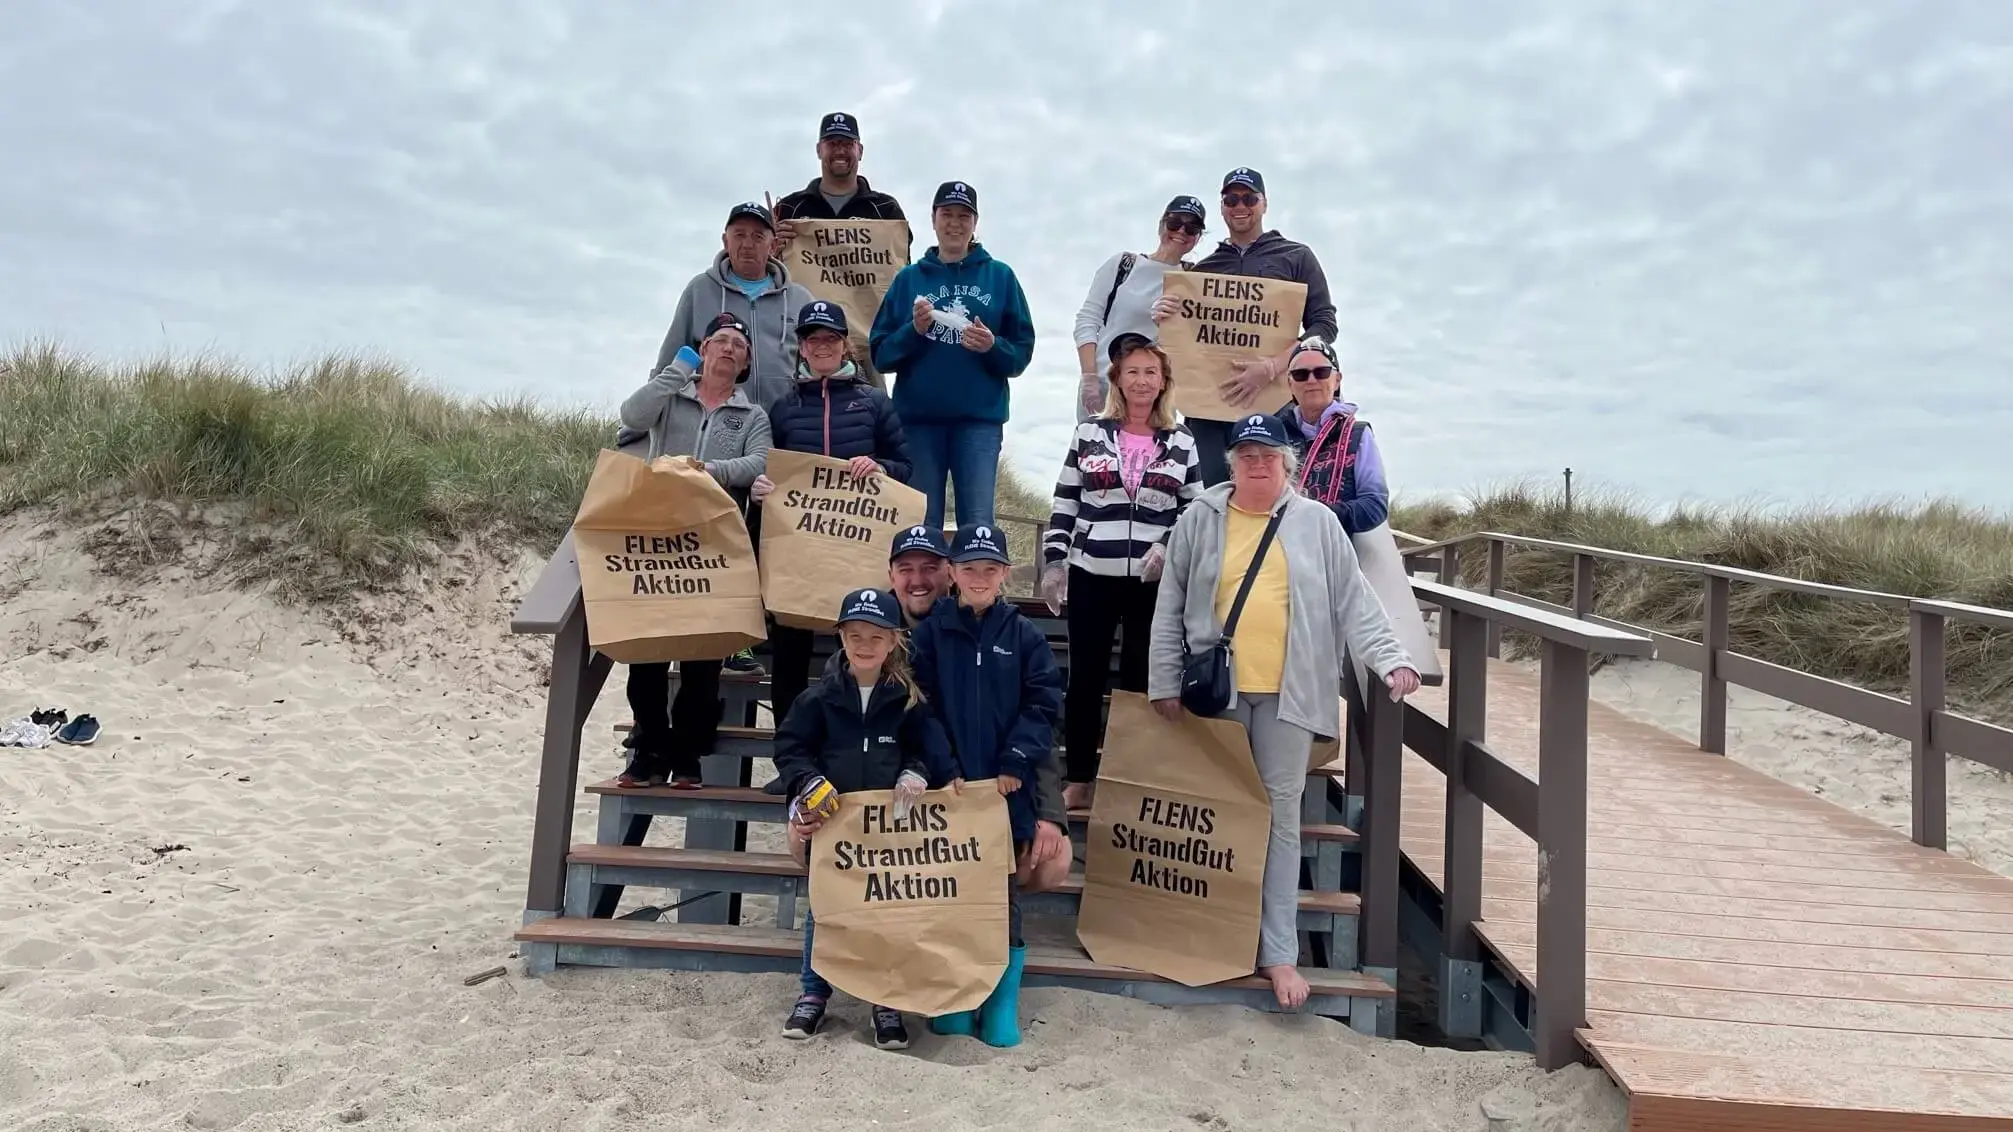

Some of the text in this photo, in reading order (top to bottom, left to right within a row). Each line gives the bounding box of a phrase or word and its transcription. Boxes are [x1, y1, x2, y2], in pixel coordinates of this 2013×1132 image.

[814, 228, 872, 248] FLENS
[801, 247, 893, 268] StrandGut
[820, 269, 877, 287] Aktion
[1203, 278, 1265, 301] FLENS
[1181, 299, 1280, 328] StrandGut
[1196, 324, 1260, 348] Aktion
[812, 466, 882, 496] FLENS
[783, 489, 899, 525] StrandGut
[796, 512, 873, 542] Aktion
[625, 532, 701, 554] FLENS
[605, 554, 730, 572] StrandGut
[633, 573, 711, 594] Aktion
[1138, 797, 1216, 835] FLENS
[834, 836, 981, 870] StrandGut
[1112, 823, 1234, 872] StrandGut
[864, 871, 957, 902] Aktion
[1130, 858, 1208, 898] Aktion
